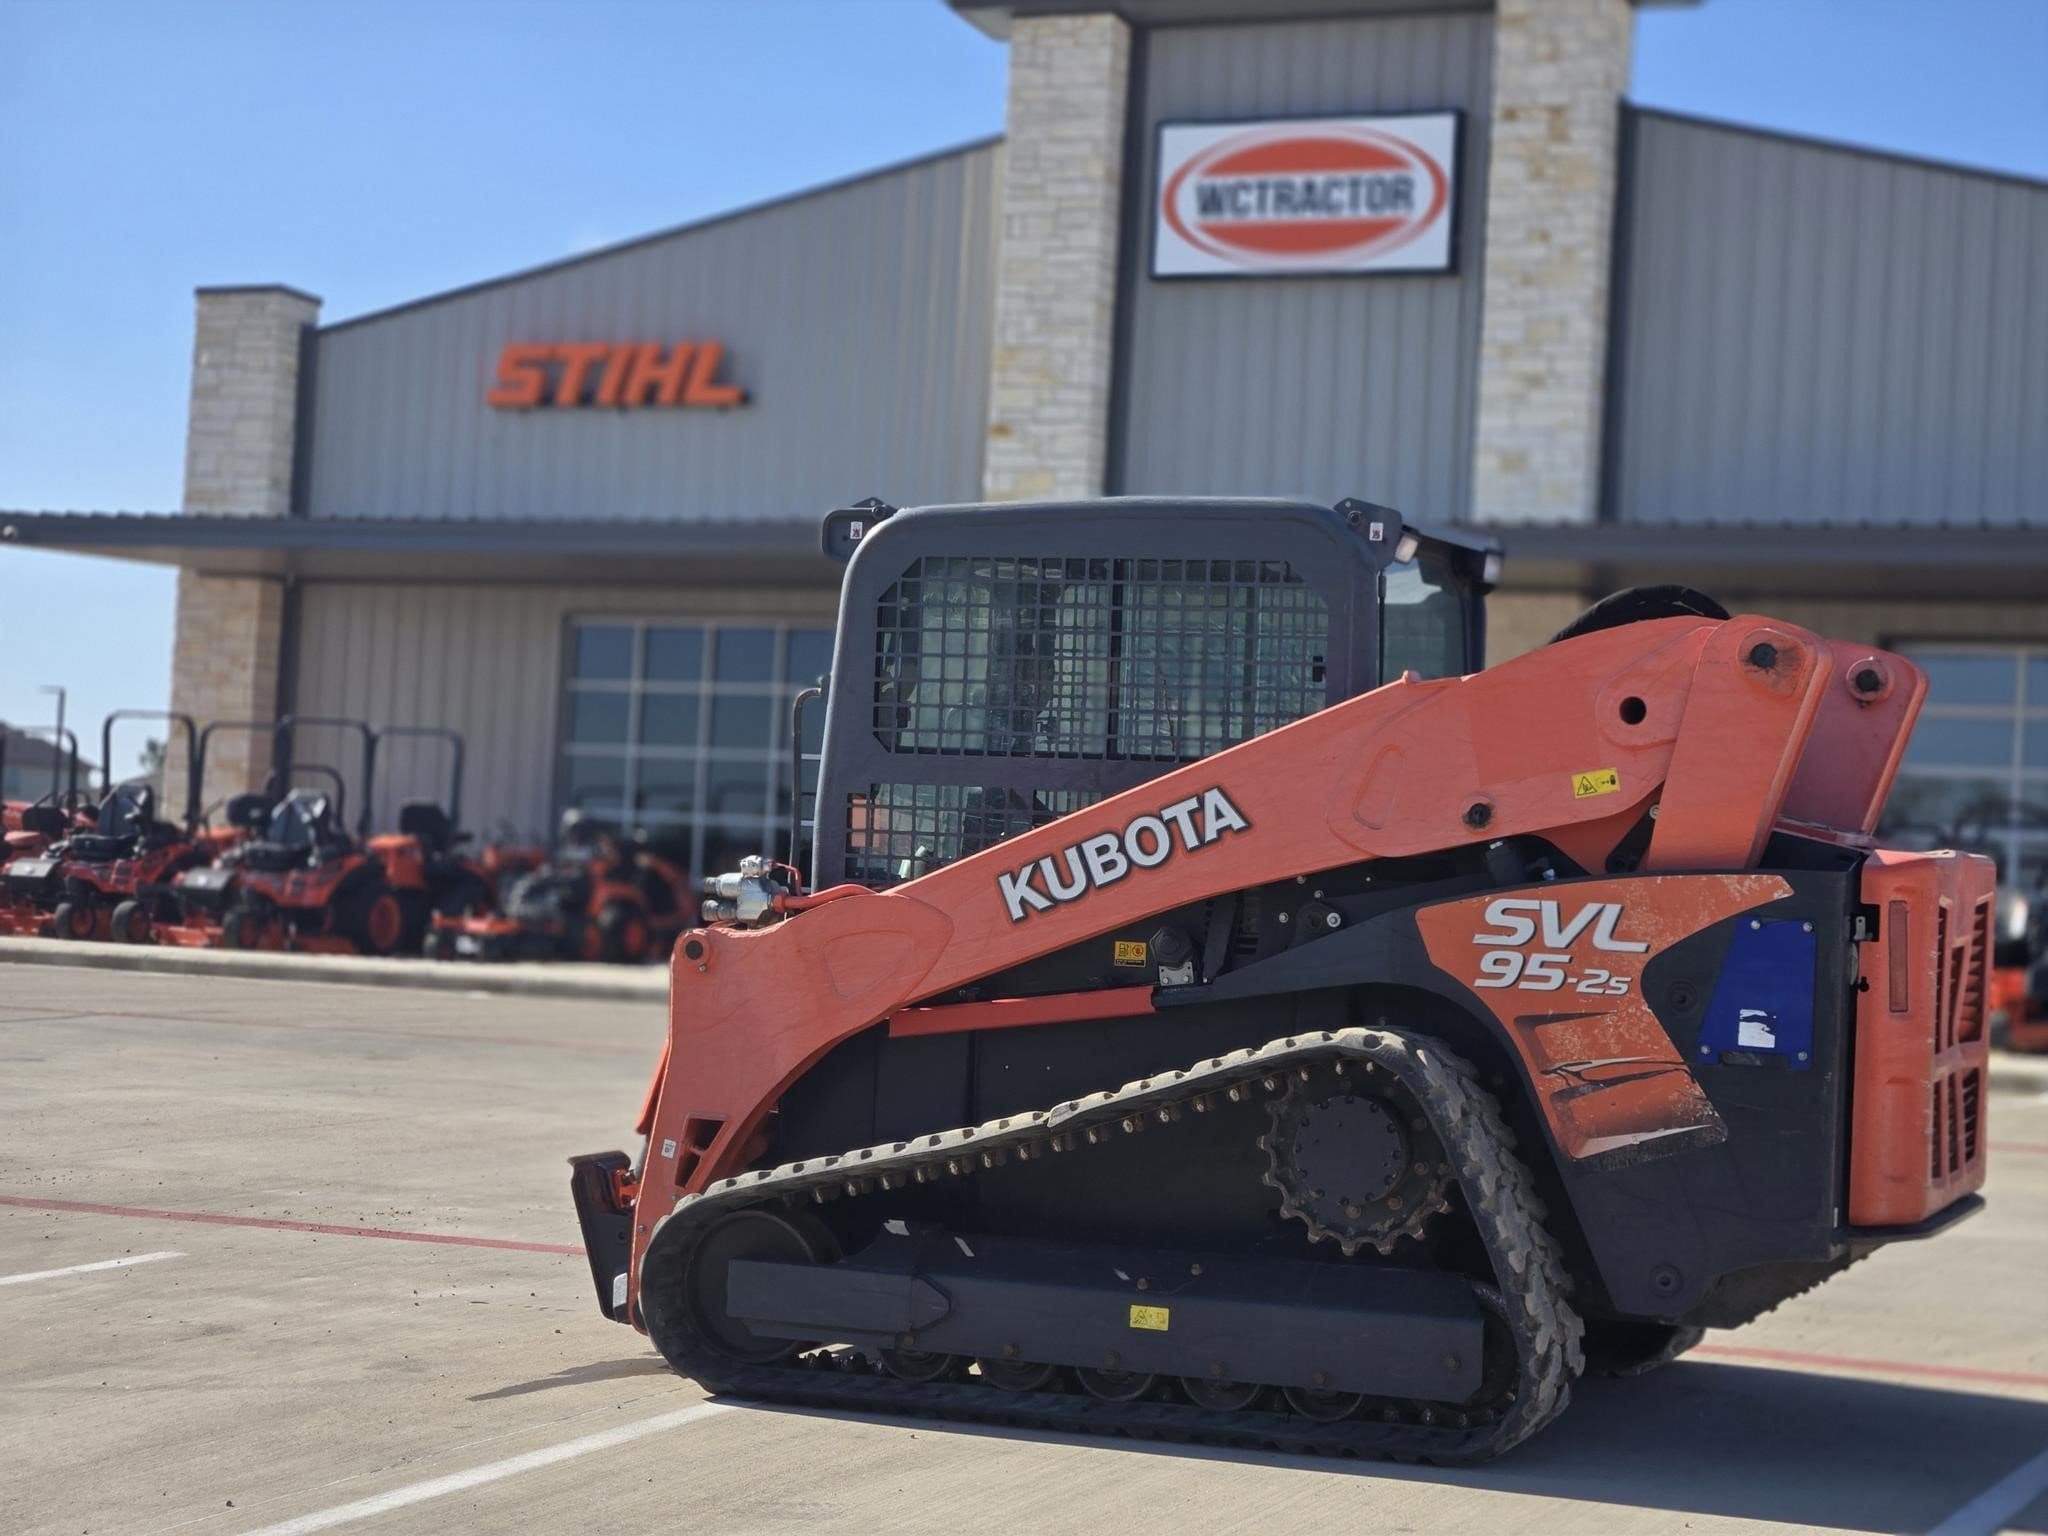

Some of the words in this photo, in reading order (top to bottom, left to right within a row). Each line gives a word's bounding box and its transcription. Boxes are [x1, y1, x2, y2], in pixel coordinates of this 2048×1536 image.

[1195, 175, 1414, 216] WCTRACTOR
[486, 340, 743, 407] STIHL
[997, 786, 1249, 922] KUBOTA
[1472, 898, 1651, 953] SVL
